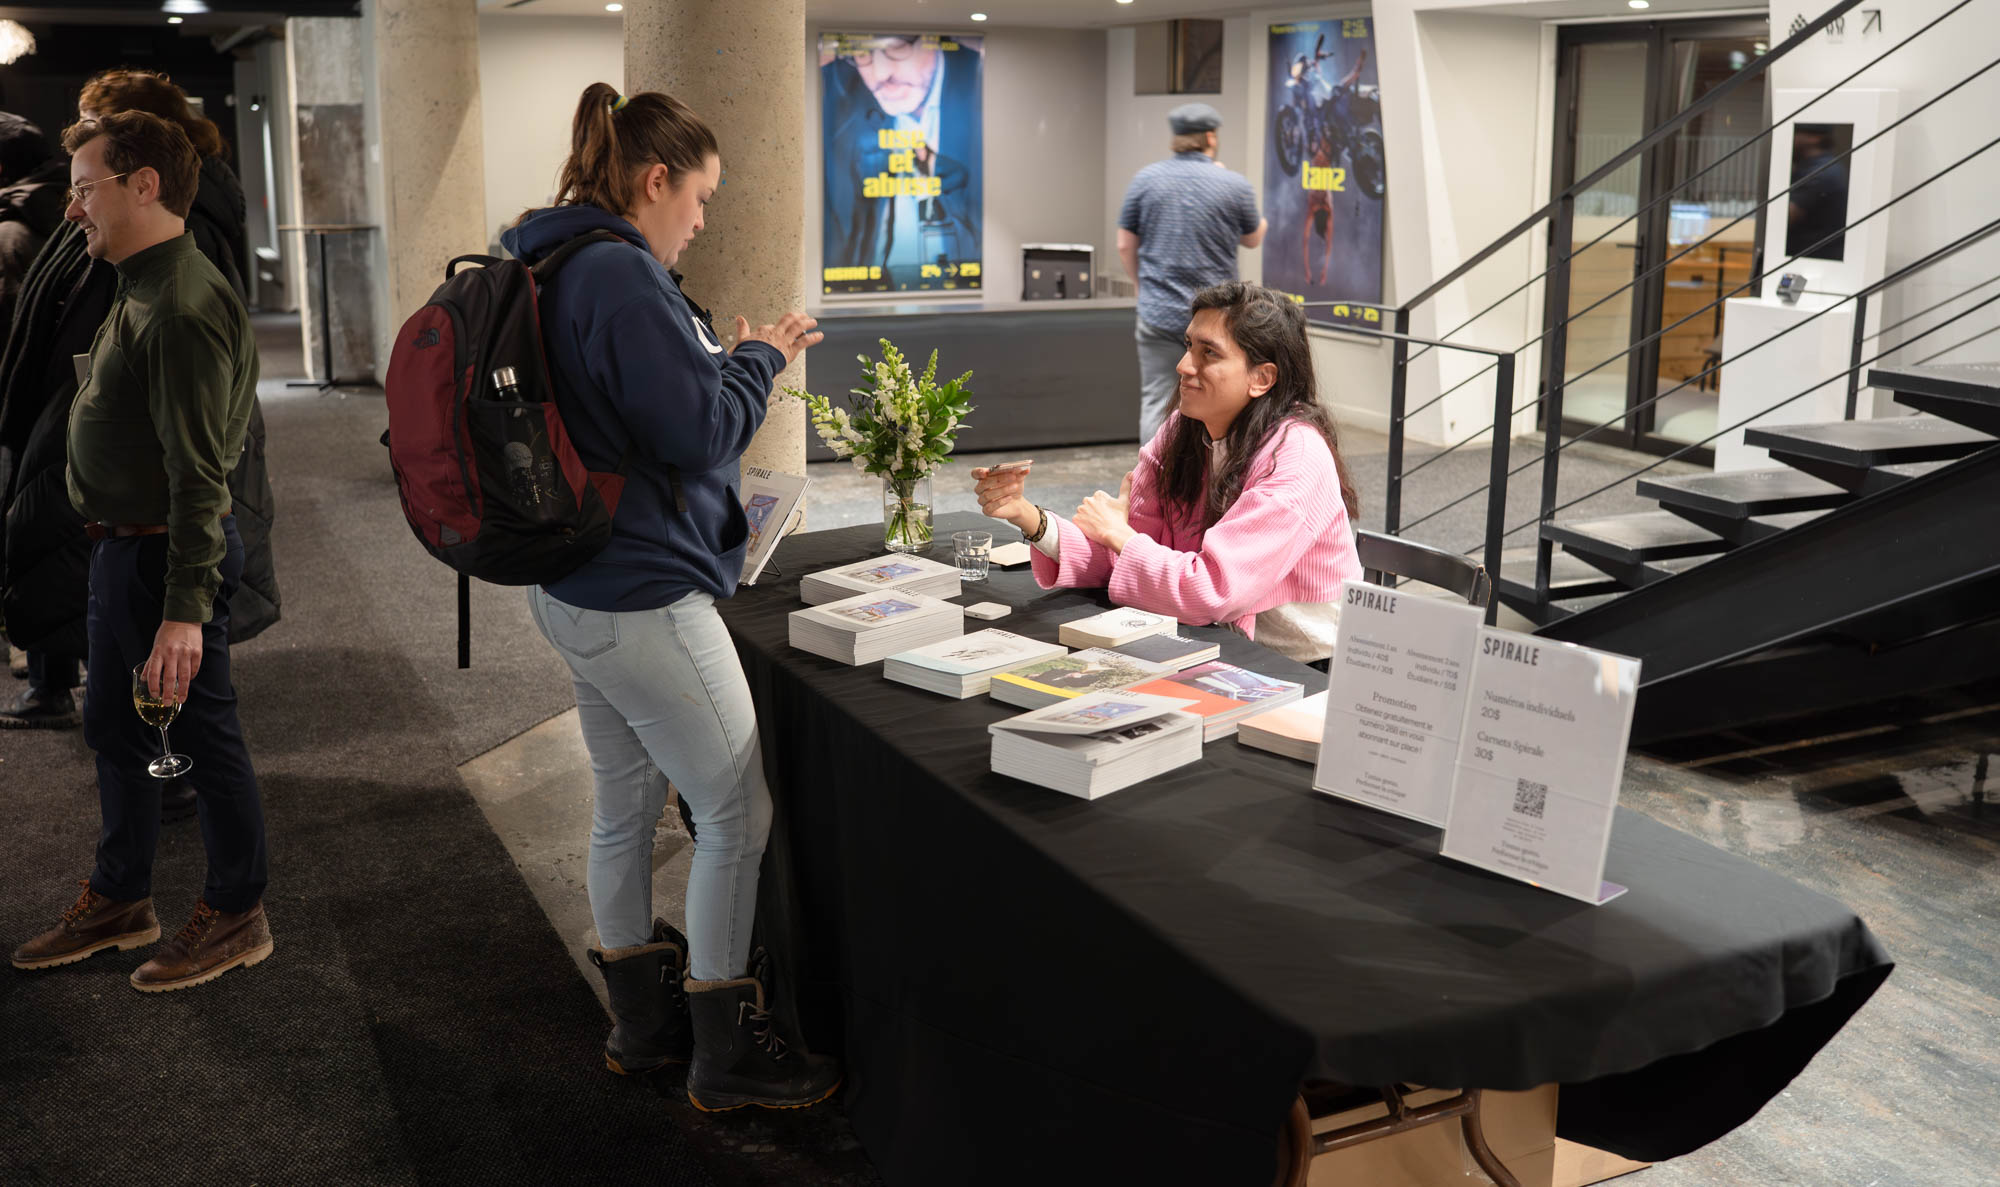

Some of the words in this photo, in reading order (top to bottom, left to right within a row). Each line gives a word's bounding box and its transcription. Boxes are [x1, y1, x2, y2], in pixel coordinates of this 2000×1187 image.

[878, 129, 926, 149] use
[888, 149, 916, 173] et
[863, 172, 942, 198] abuse
[1302, 160, 1345, 192] tanz
[747, 466, 773, 480] SPIRALE
[1348, 588, 1397, 614] SPIRALE
[1483, 637, 1540, 666] SPIRALE
[1373, 691, 1417, 712] Promotion
[1481, 706, 1501, 721] 20$
[1483, 689, 1525, 710] Numéros
[1526, 700, 1576, 722] individuels
[1474, 747, 1494, 761] 30$
[1477, 731, 1512, 748] Carnets
[1512, 740, 1545, 758] Spirale
